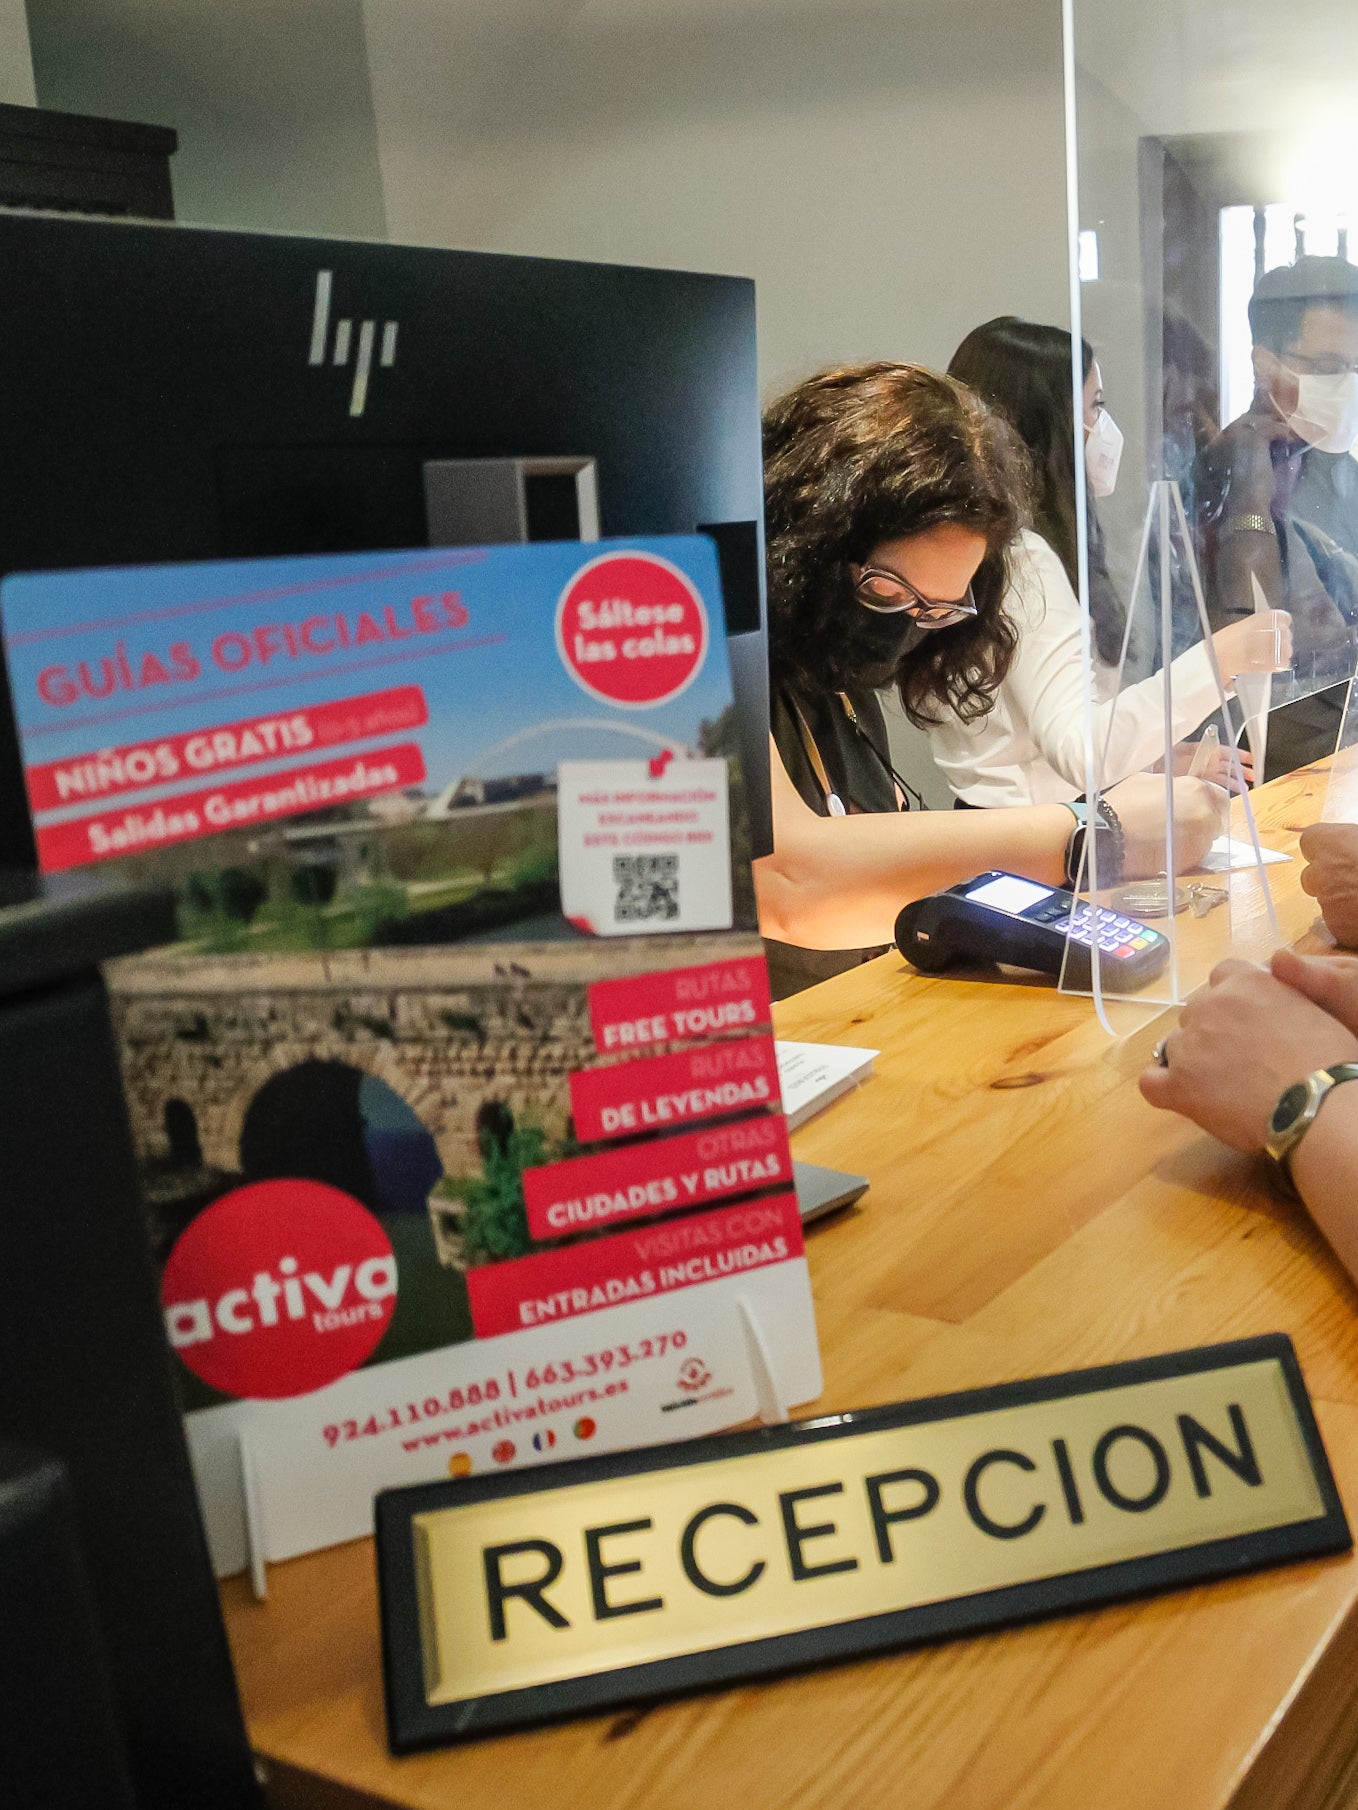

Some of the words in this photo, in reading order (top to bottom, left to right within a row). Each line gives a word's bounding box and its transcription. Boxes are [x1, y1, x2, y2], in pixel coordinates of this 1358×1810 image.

[308, 269, 399, 417] hp
[36, 639, 201, 707] GUÍAS
[212, 591, 469, 672] OFICIALES
[575, 633, 617, 662] las
[622, 626, 695, 659] colas
[578, 597, 684, 630] Sáltese
[54, 744, 180, 799] NIÑOS
[184, 715, 313, 769] GRATIS
[88, 806, 200, 854] Salidas
[204, 762, 398, 825] Garantizadas
[675, 967, 752, 999] RUTAS
[603, 1015, 668, 1048] FREE
[673, 999, 757, 1034] TOURS
[690, 1044, 767, 1079] RUTAS
[601, 1102, 636, 1131] DE
[641, 1075, 771, 1122] LEYENDAS
[696, 1121, 778, 1161] OTRAS
[547, 1178, 677, 1228] CIUDADES
[681, 1172, 699, 1196] Y
[703, 1153, 781, 1190] RUTAS
[634, 1219, 723, 1261] VISITAS
[725, 1207, 784, 1239] CON
[164, 1254, 398, 1349] activa
[313, 1301, 383, 1333] tours
[519, 1271, 656, 1325] ENTRADAS
[659, 1236, 789, 1288] INCLUIDAS
[322, 1377, 500, 1450] 924.110.888
[525, 1330, 688, 1389] 663.393.270
[402, 1378, 630, 1453] www.activatours.es
[482, 1403, 1264, 1641] RECEPCION
